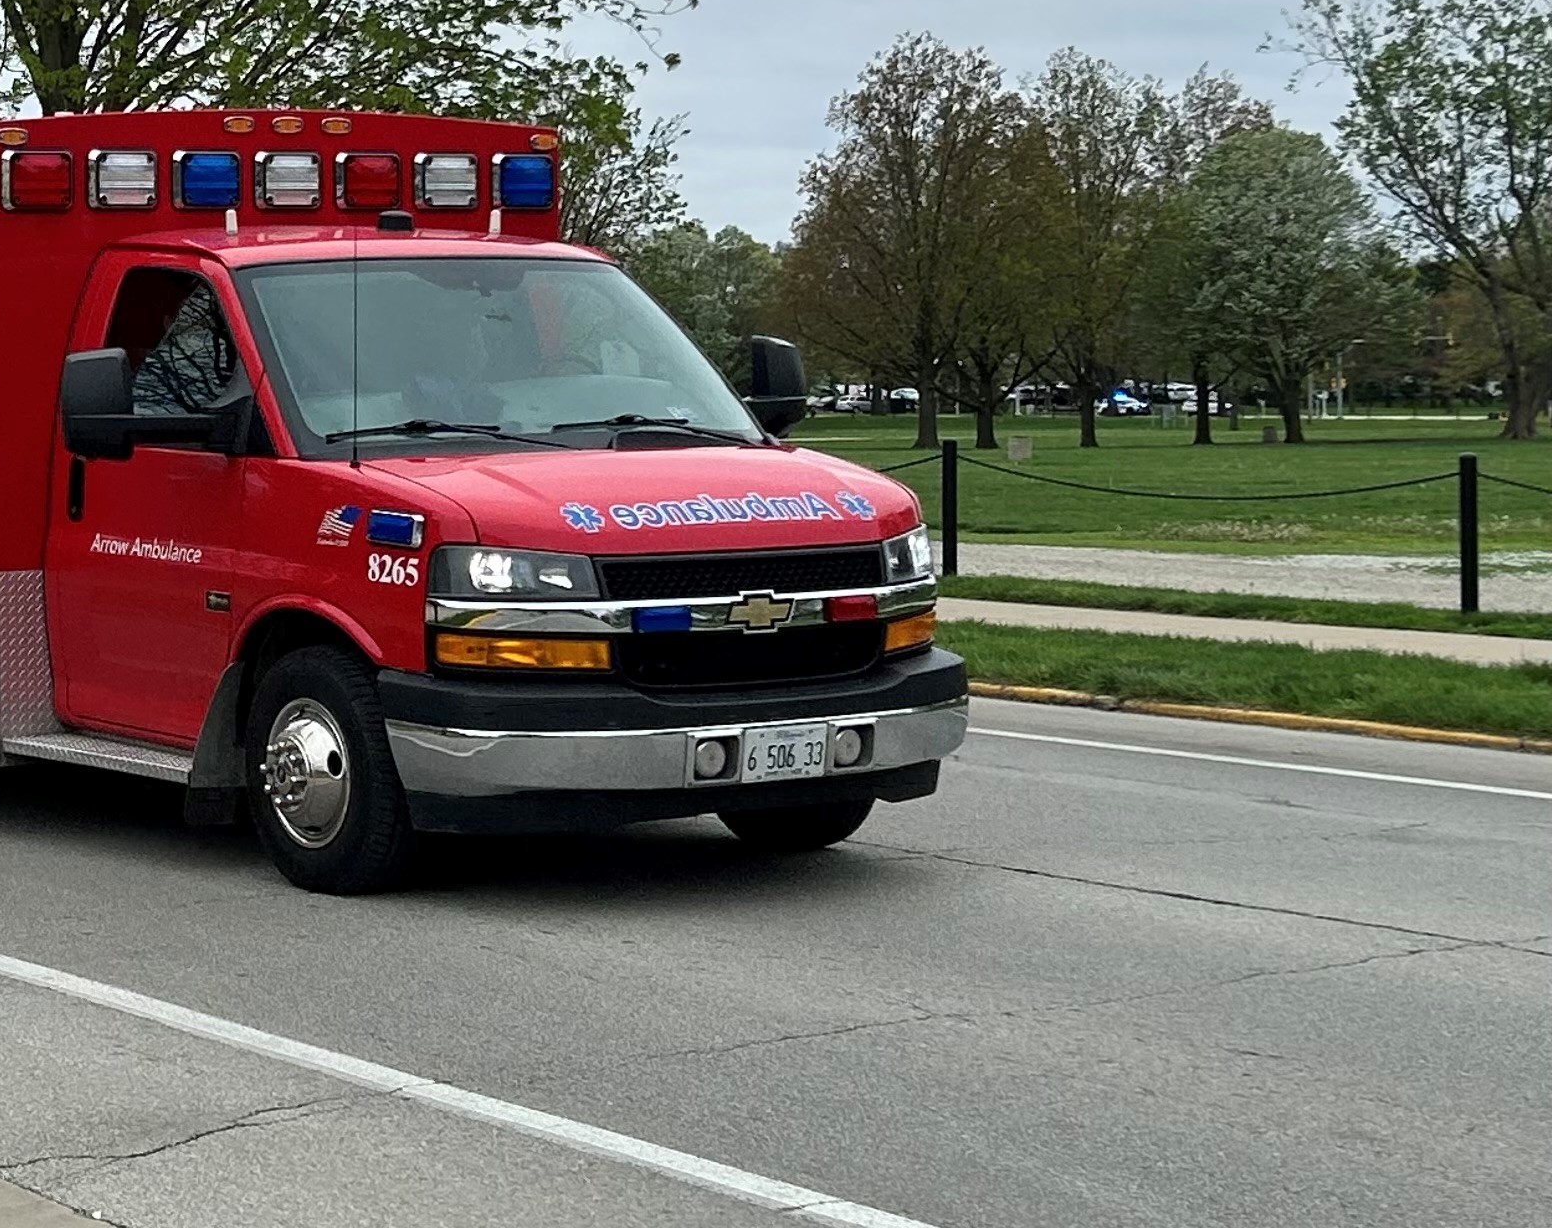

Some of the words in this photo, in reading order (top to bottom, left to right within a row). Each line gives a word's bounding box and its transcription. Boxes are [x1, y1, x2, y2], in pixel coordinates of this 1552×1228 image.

[90, 532, 129, 556] Arrow
[129, 536, 202, 564] Ambulance
[368, 553, 419, 587] 8265
[747, 746, 758, 772] 6
[766, 742, 796, 770] 506
[803, 740, 824, 767] 33
